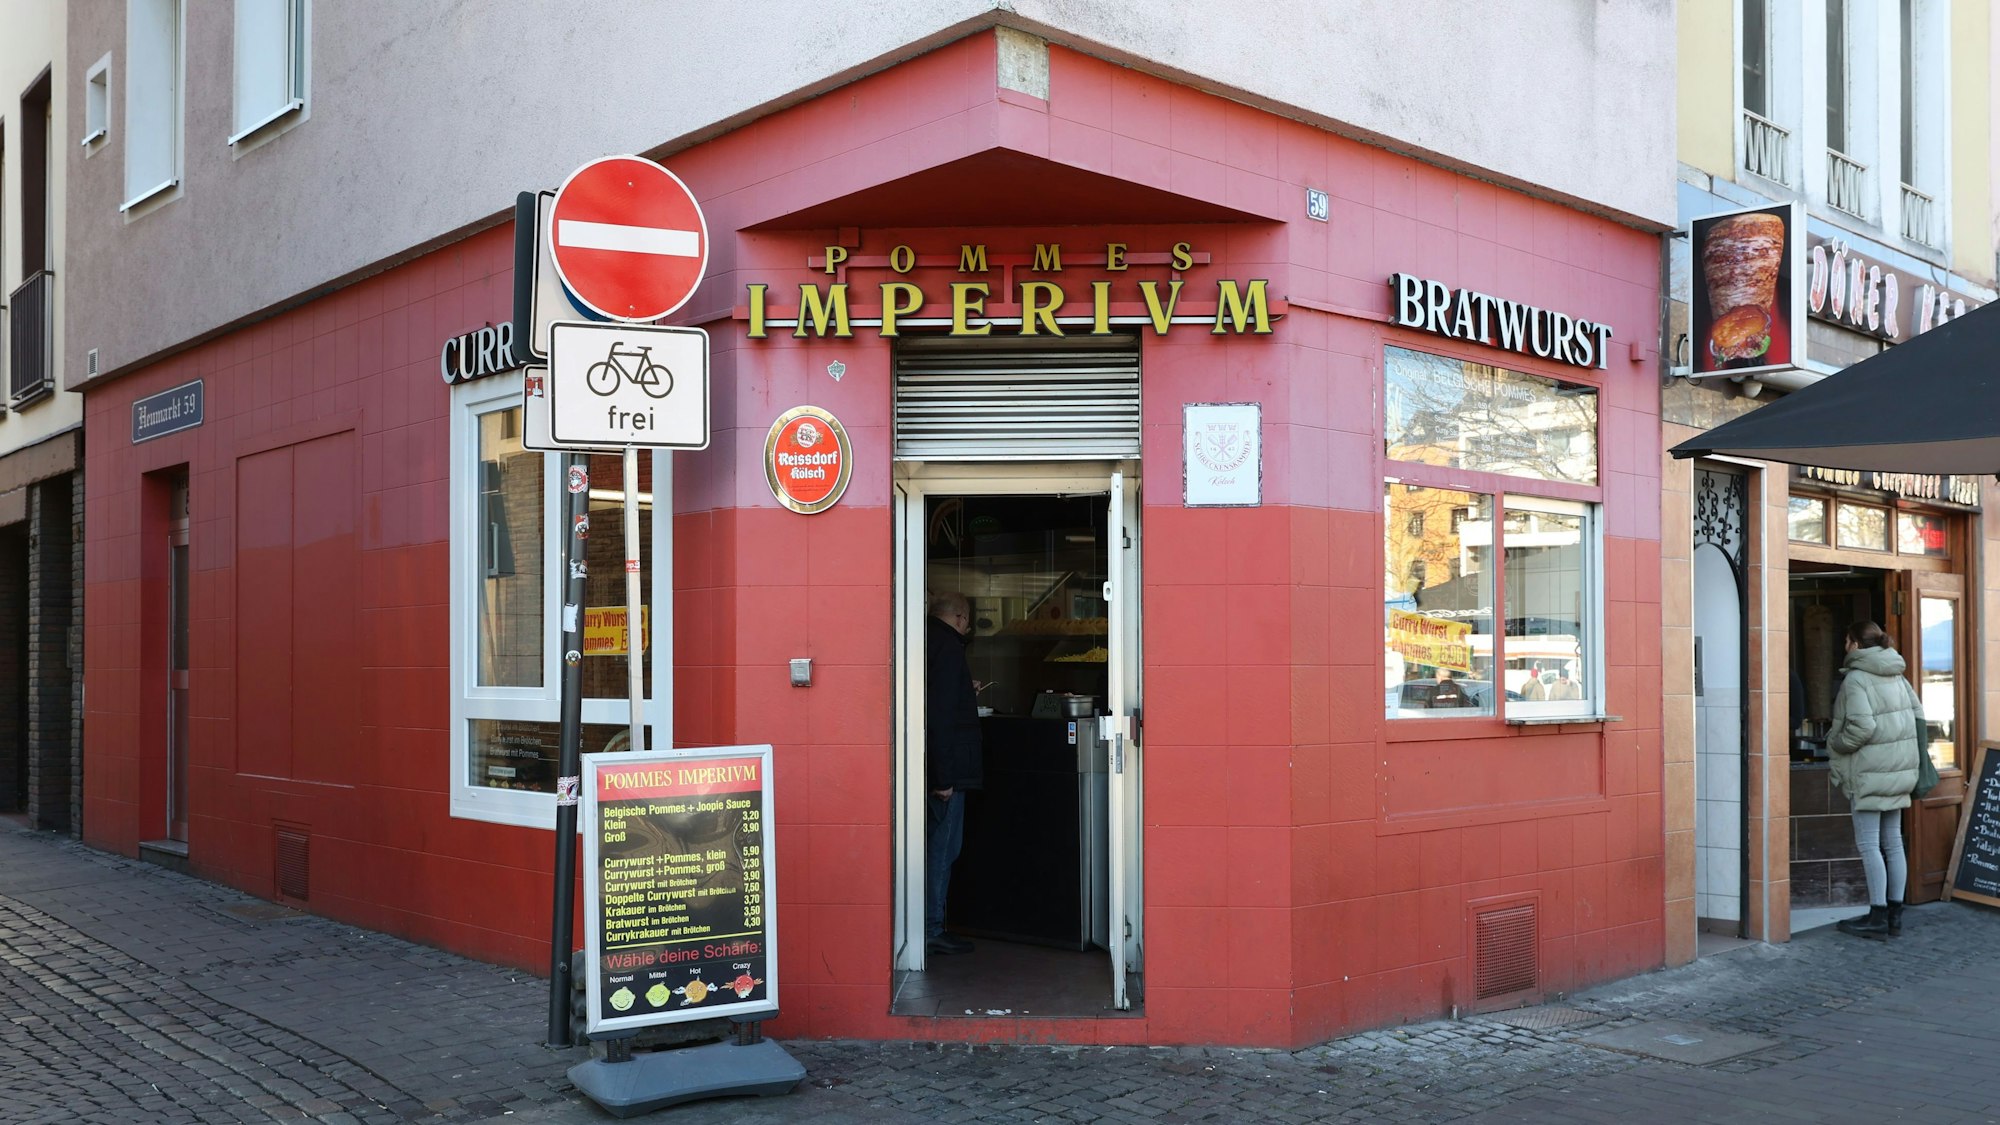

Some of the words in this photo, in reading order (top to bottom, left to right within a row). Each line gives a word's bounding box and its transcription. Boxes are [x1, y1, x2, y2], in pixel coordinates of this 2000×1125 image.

[1310, 191, 1327, 217] 59
[824, 242, 1194, 274] POMMES
[1810, 236, 1899, 338] DÖNER
[746, 279, 1274, 339] IMPERIVM
[1396, 272, 1614, 370] BRATWURST
[441, 321, 516, 384] CURR
[1494, 383, 1537, 403] POMMES
[138, 397, 181, 431] Heumarkt
[184, 393, 196, 415] 59
[608, 405, 654, 430] frei
[778, 451, 838, 466] Reissdorf
[790, 466, 826, 480] Kölsch
[584, 611, 601, 629] urry
[1393, 612, 1419, 635] Curry
[1420, 618, 1448, 640] Wurst
[584, 636, 615, 651] ommes
[604, 770, 673, 790] POMMES
[678, 765, 757, 786] IMPERIVM
[604, 806, 646, 819] Belgische
[649, 804, 686, 815] Pommes
[696, 801, 724, 812] Joopie
[726, 799, 751, 810] Sauce
[604, 820, 626, 830] Klein
[742, 811, 760, 821] 3,20
[604, 832, 626, 843] Groß
[742, 823, 760, 833] 3,90
[604, 856, 654, 869] Currywurst
[706, 850, 726, 861] klein
[743, 846, 760, 856] 5,90
[604, 867, 654, 881] Currywurst
[706, 861, 726, 874] groß
[744, 858, 760, 868] 7,30
[605, 879, 655, 893] Currywurst
[657, 880, 668, 888] mit
[669, 878, 697, 887] Brötchen
[743, 871, 760, 881] 3,90
[605, 892, 645, 906] Doppelte
[647, 888, 696, 902] Currywurst
[698, 888, 708, 896] mit
[744, 882, 760, 893] 7,50
[605, 905, 646, 917] Krakauer
[658, 903, 686, 913] Brötchen
[744, 894, 760, 905] 3,70
[605, 916, 649, 930] Bratwurst
[651, 918, 660, 926] im
[661, 915, 689, 925] Brötchen
[744, 906, 761, 916] 3,50
[606, 927, 670, 942] Currykrakauer
[671, 928, 682, 936] mit
[683, 925, 711, 935] Brötchen
[744, 917, 761, 928] 4,30
[606, 952, 655, 969] Wähle
[659, 949, 699, 964] deine
[704, 940, 762, 959] Schärfe:
[649, 971, 667, 979] Mittel
[689, 967, 702, 975] Hot
[732, 962, 751, 971] Crazy
[609, 974, 634, 983] Normal
